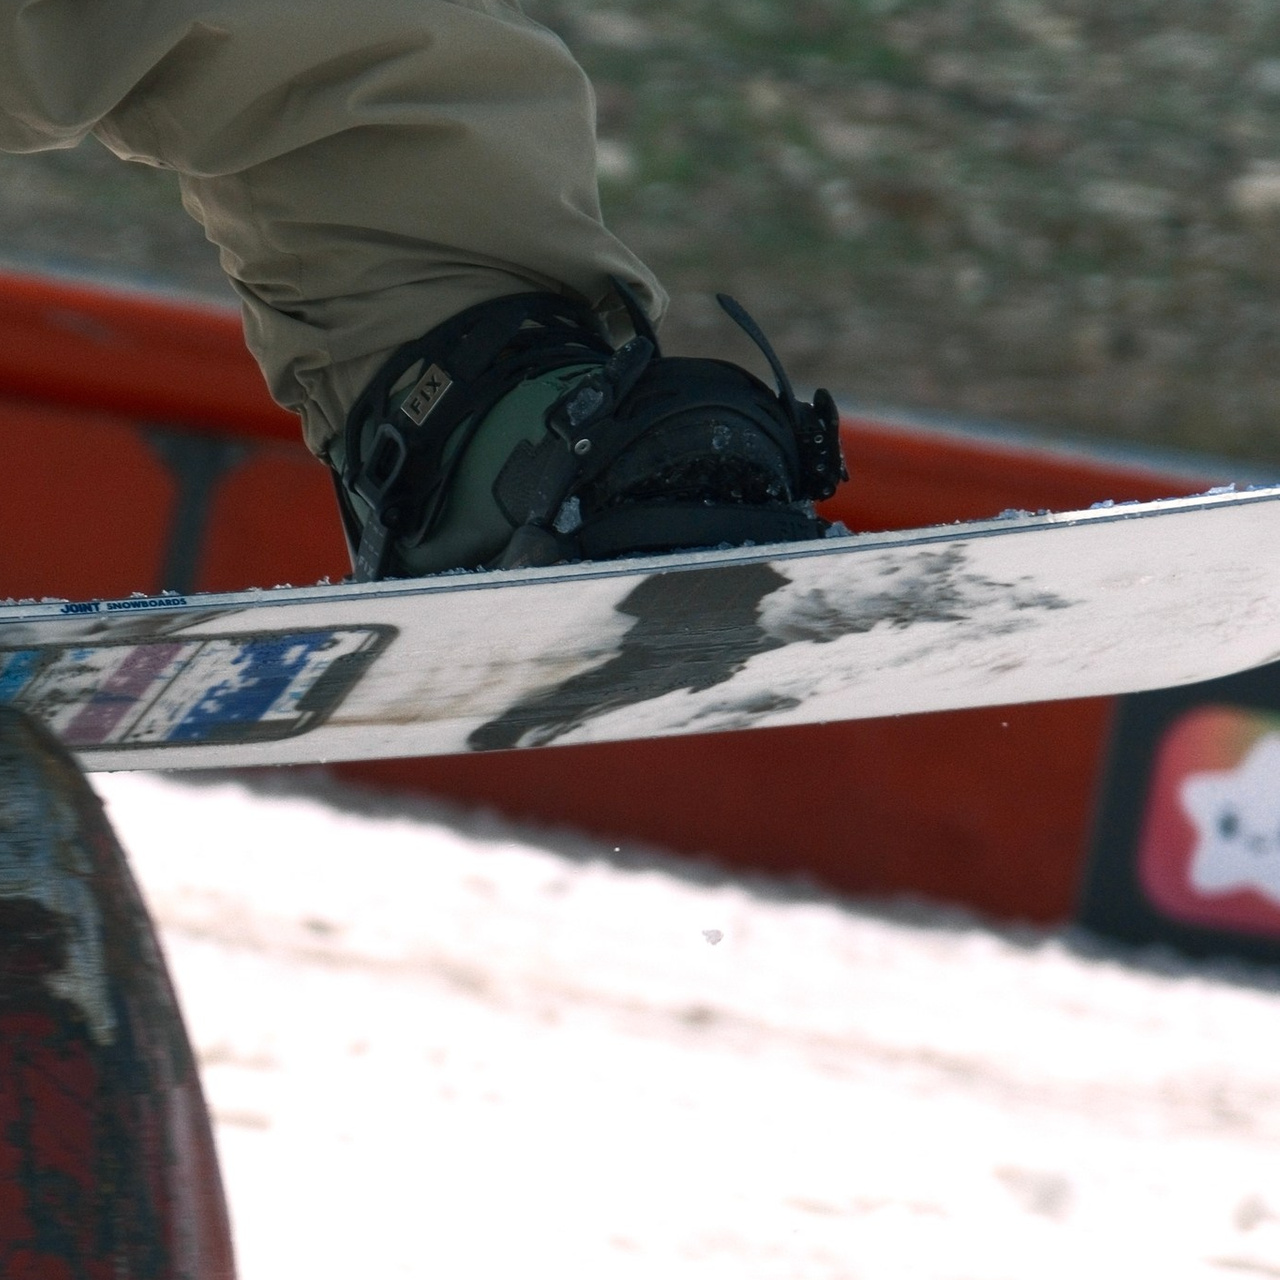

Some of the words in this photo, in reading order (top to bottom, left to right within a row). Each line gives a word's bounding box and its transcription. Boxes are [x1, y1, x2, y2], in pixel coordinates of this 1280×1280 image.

[409, 375, 442, 415] FIX
[60, 602, 100, 614] JOINT
[108, 597, 187, 610] SNOWBOARDS
